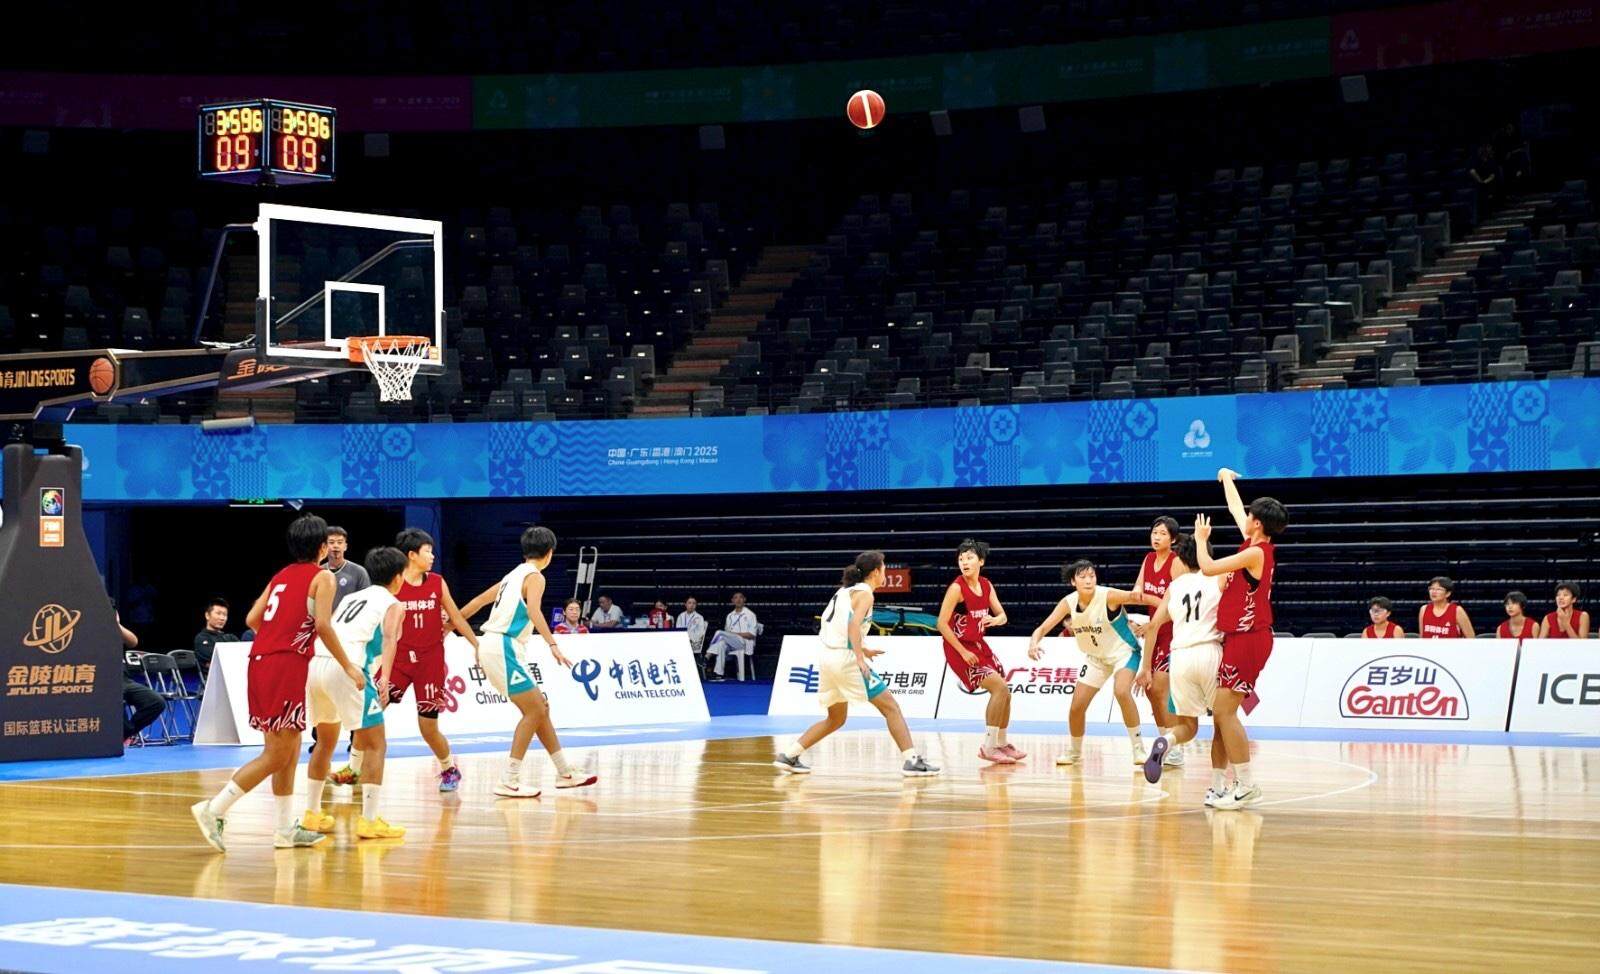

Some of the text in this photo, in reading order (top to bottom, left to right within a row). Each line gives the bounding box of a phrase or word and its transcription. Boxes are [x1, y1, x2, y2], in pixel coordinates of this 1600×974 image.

[694, 446, 718, 456] 2025
[263, 583, 288, 621] 5
[1182, 589, 1202, 623] 11
[336, 599, 368, 624] 10
[413, 613, 424, 628] 11
[6, 663, 97, 686] 金陵体育
[468, 662, 544, 687] 中通
[608, 658, 682, 690] 中国电信
[878, 671, 928, 688] 方电网
[1006, 667, 1078, 684] 广汽集
[1079, 664, 1088, 678] 8
[1367, 665, 1437, 685] 百岁山
[51, 685, 94, 694] SPORTS
[615, 689, 686, 700] CHINA TELECOM
[1039, 684, 1075, 695] GRO
[4, 717, 100, 736] 国际篮联认证器材
